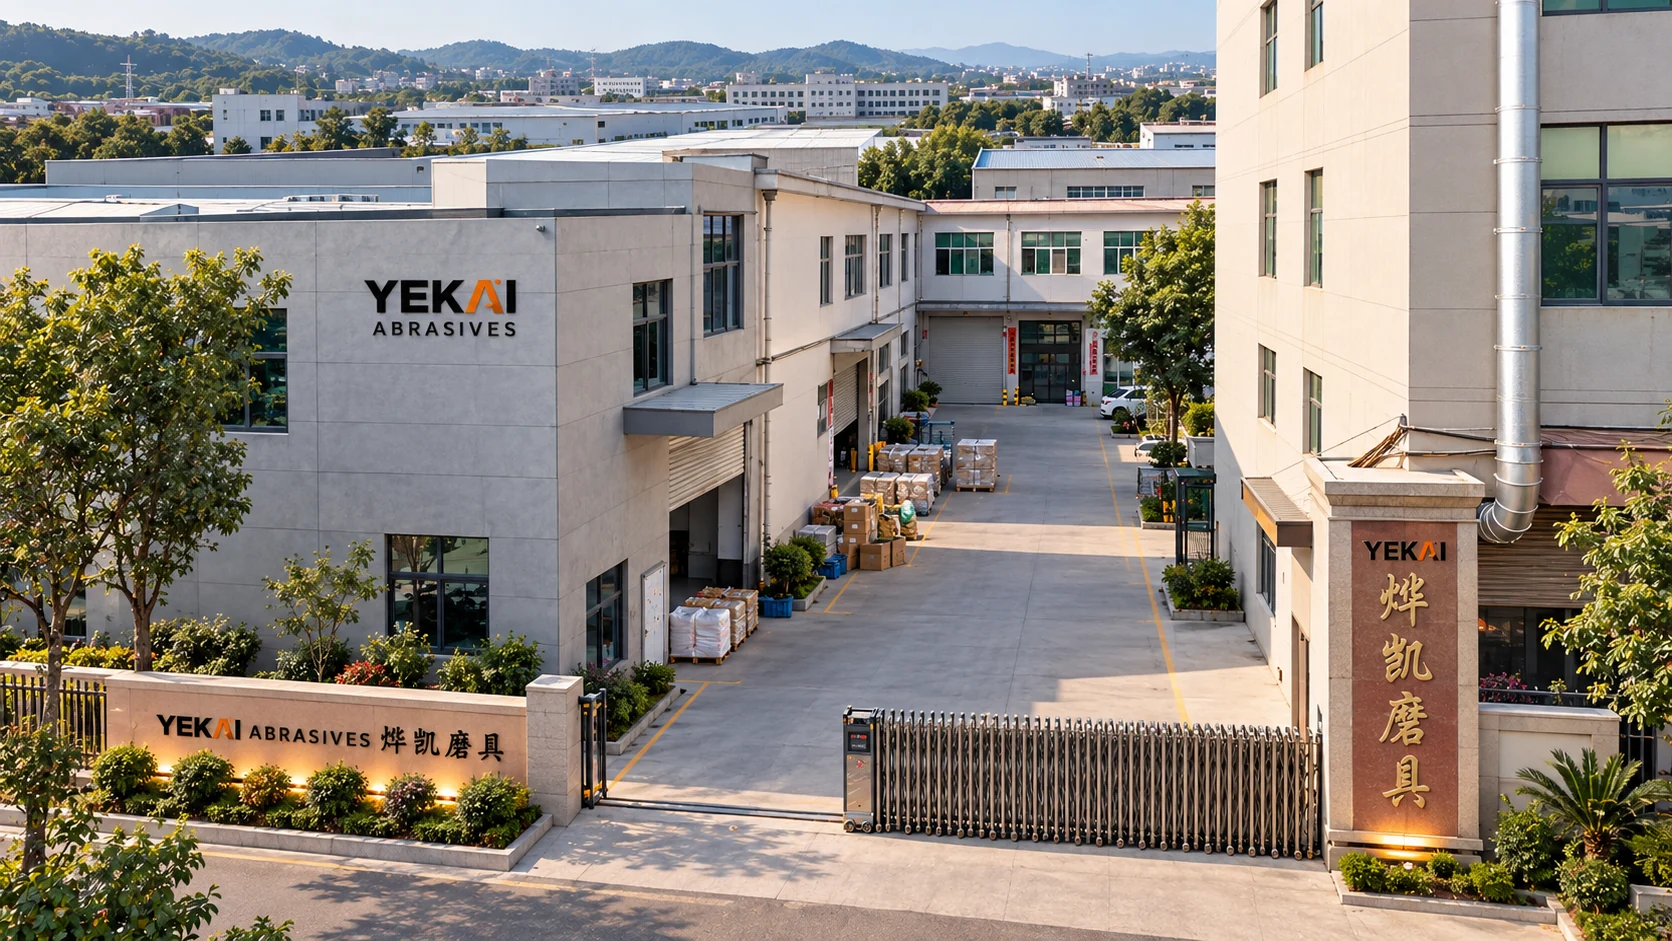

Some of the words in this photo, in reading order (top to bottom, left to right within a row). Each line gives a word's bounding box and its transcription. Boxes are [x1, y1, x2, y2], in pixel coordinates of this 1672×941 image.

[364, 279, 517, 314] YEKAI
[373, 321, 517, 337] ABRASIVES
[1362, 540, 1447, 561] YEKAI
[1379, 572, 1434, 809] 烨凯磨具
[156, 714, 241, 740] YEKAI
[249, 725, 371, 748] ABRASIVES
[381, 725, 504, 762] 烨凯磨具
